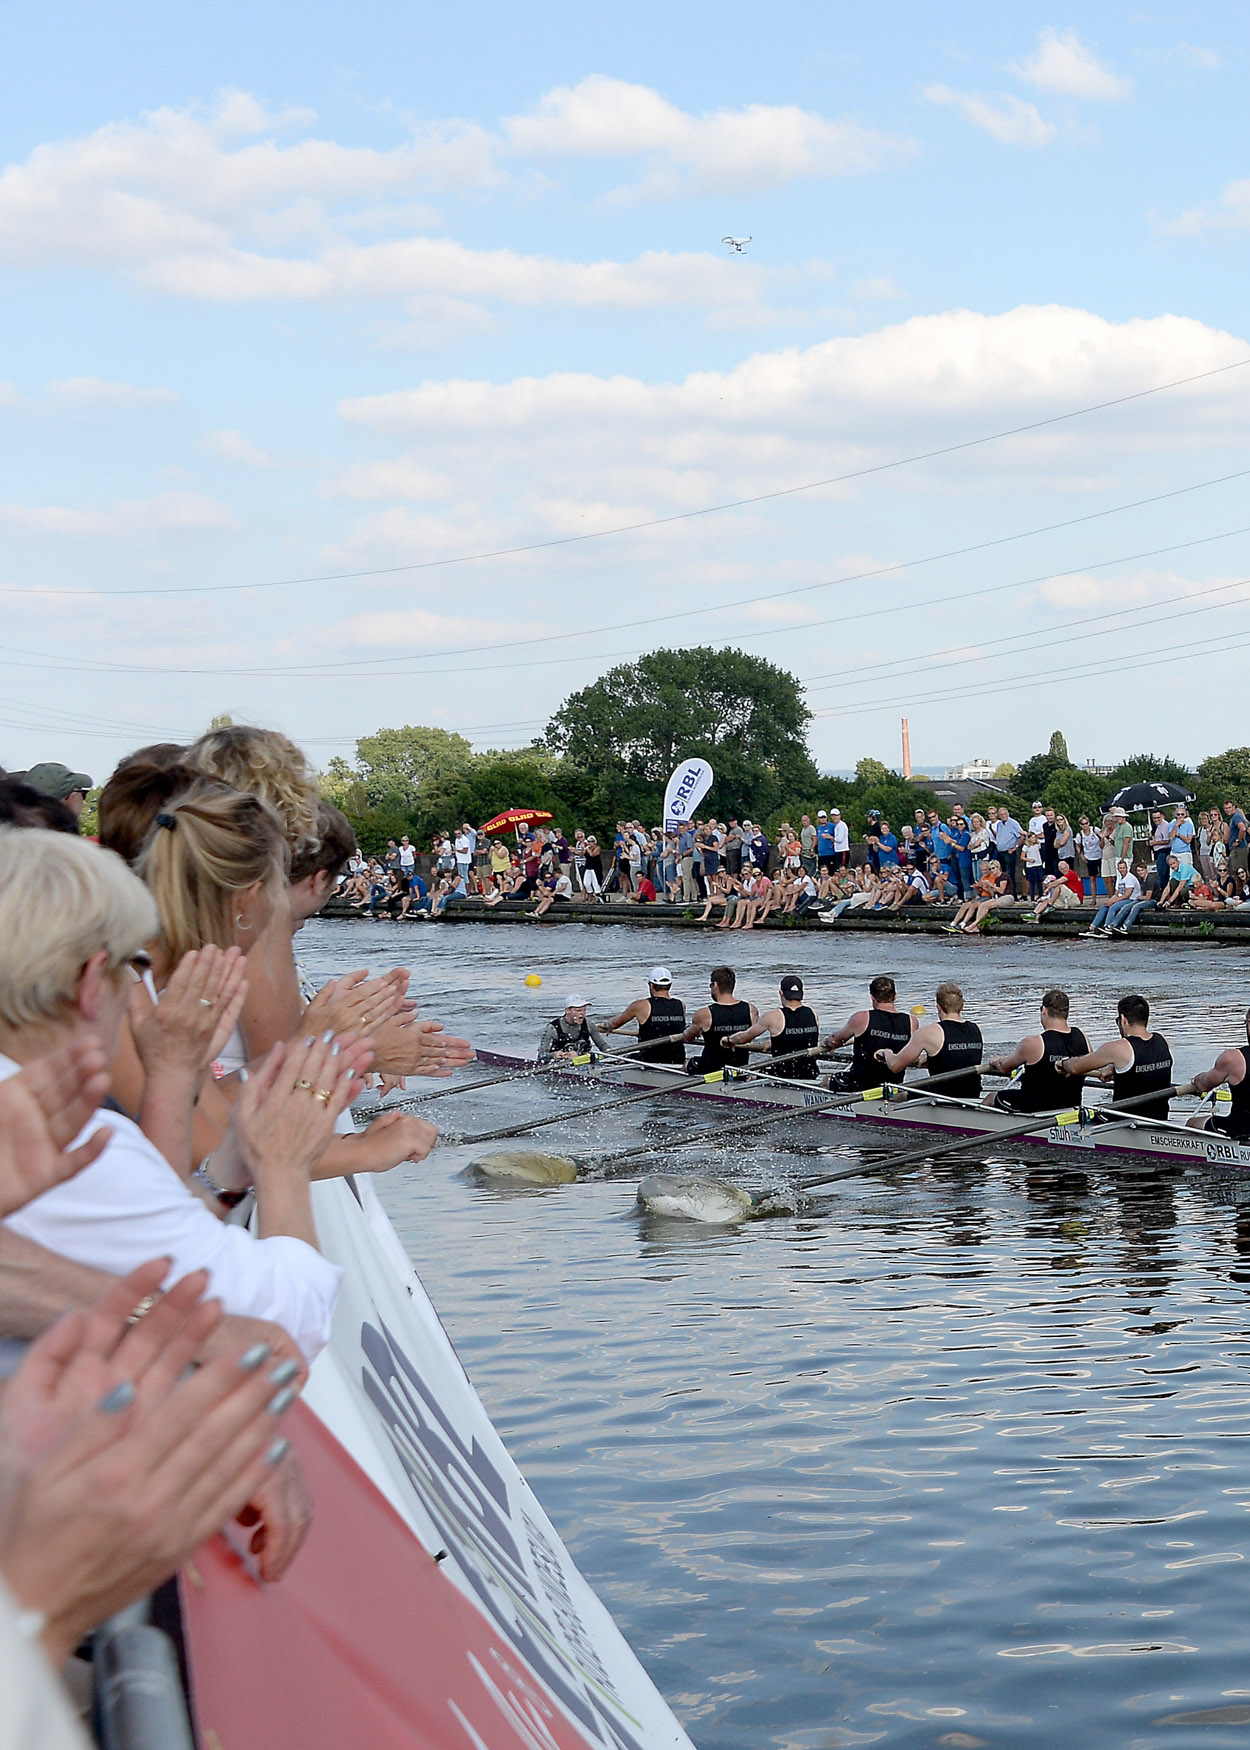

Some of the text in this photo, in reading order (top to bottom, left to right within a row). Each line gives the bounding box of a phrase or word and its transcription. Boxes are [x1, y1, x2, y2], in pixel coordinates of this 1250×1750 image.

[677, 768, 702, 799] RBL
[1150, 1135, 1205, 1151] EMSCHERKRAFT
[1217, 1143, 1239, 1160] RBL
